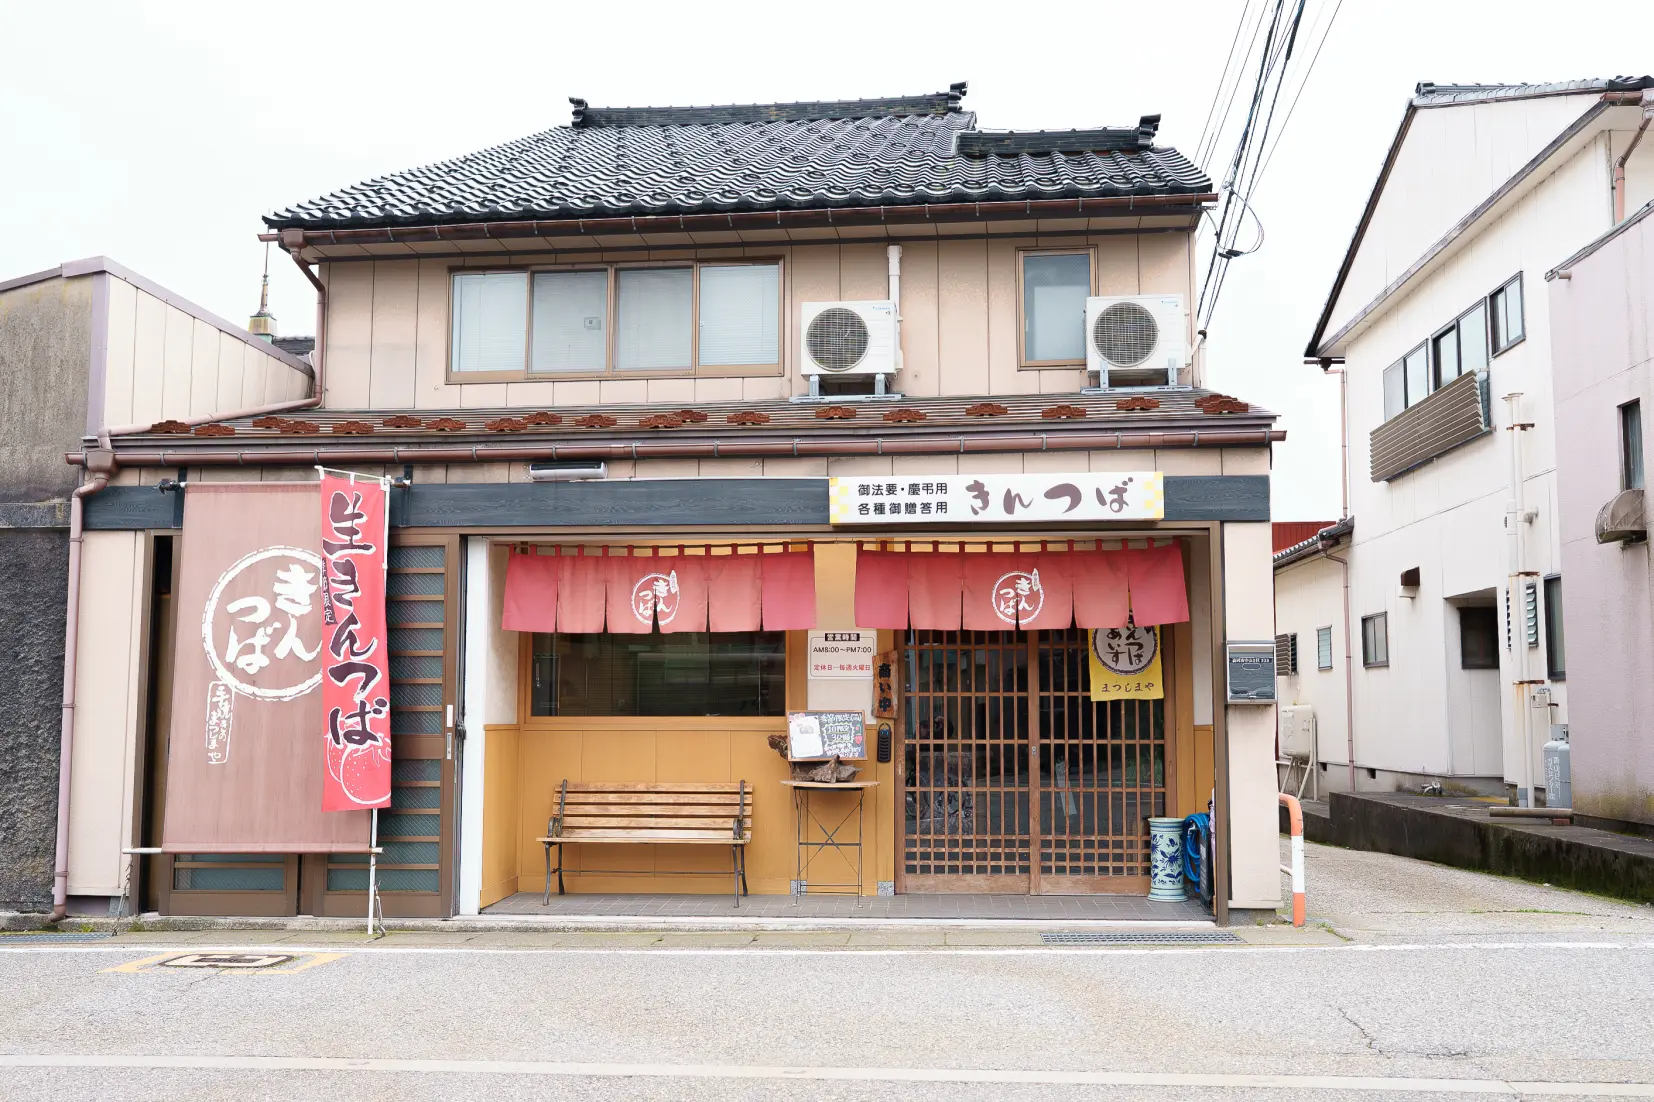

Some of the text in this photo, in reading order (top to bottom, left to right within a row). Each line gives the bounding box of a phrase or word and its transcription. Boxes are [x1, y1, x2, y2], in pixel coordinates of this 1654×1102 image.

[857, 482, 948, 497] 御法要・慶弔用
[857, 501, 948, 515] 各種御贈答用
[964, 476, 1134, 516] きんつば
[273, 563, 323, 662] きん
[321, 490, 389, 748] 生きんつば
[225, 596, 282, 675] つば
[826, 633, 858, 641] 営業時間
[878, 662, 892, 712] 商い中
[1102, 682, 1154, 693] まつしまや
